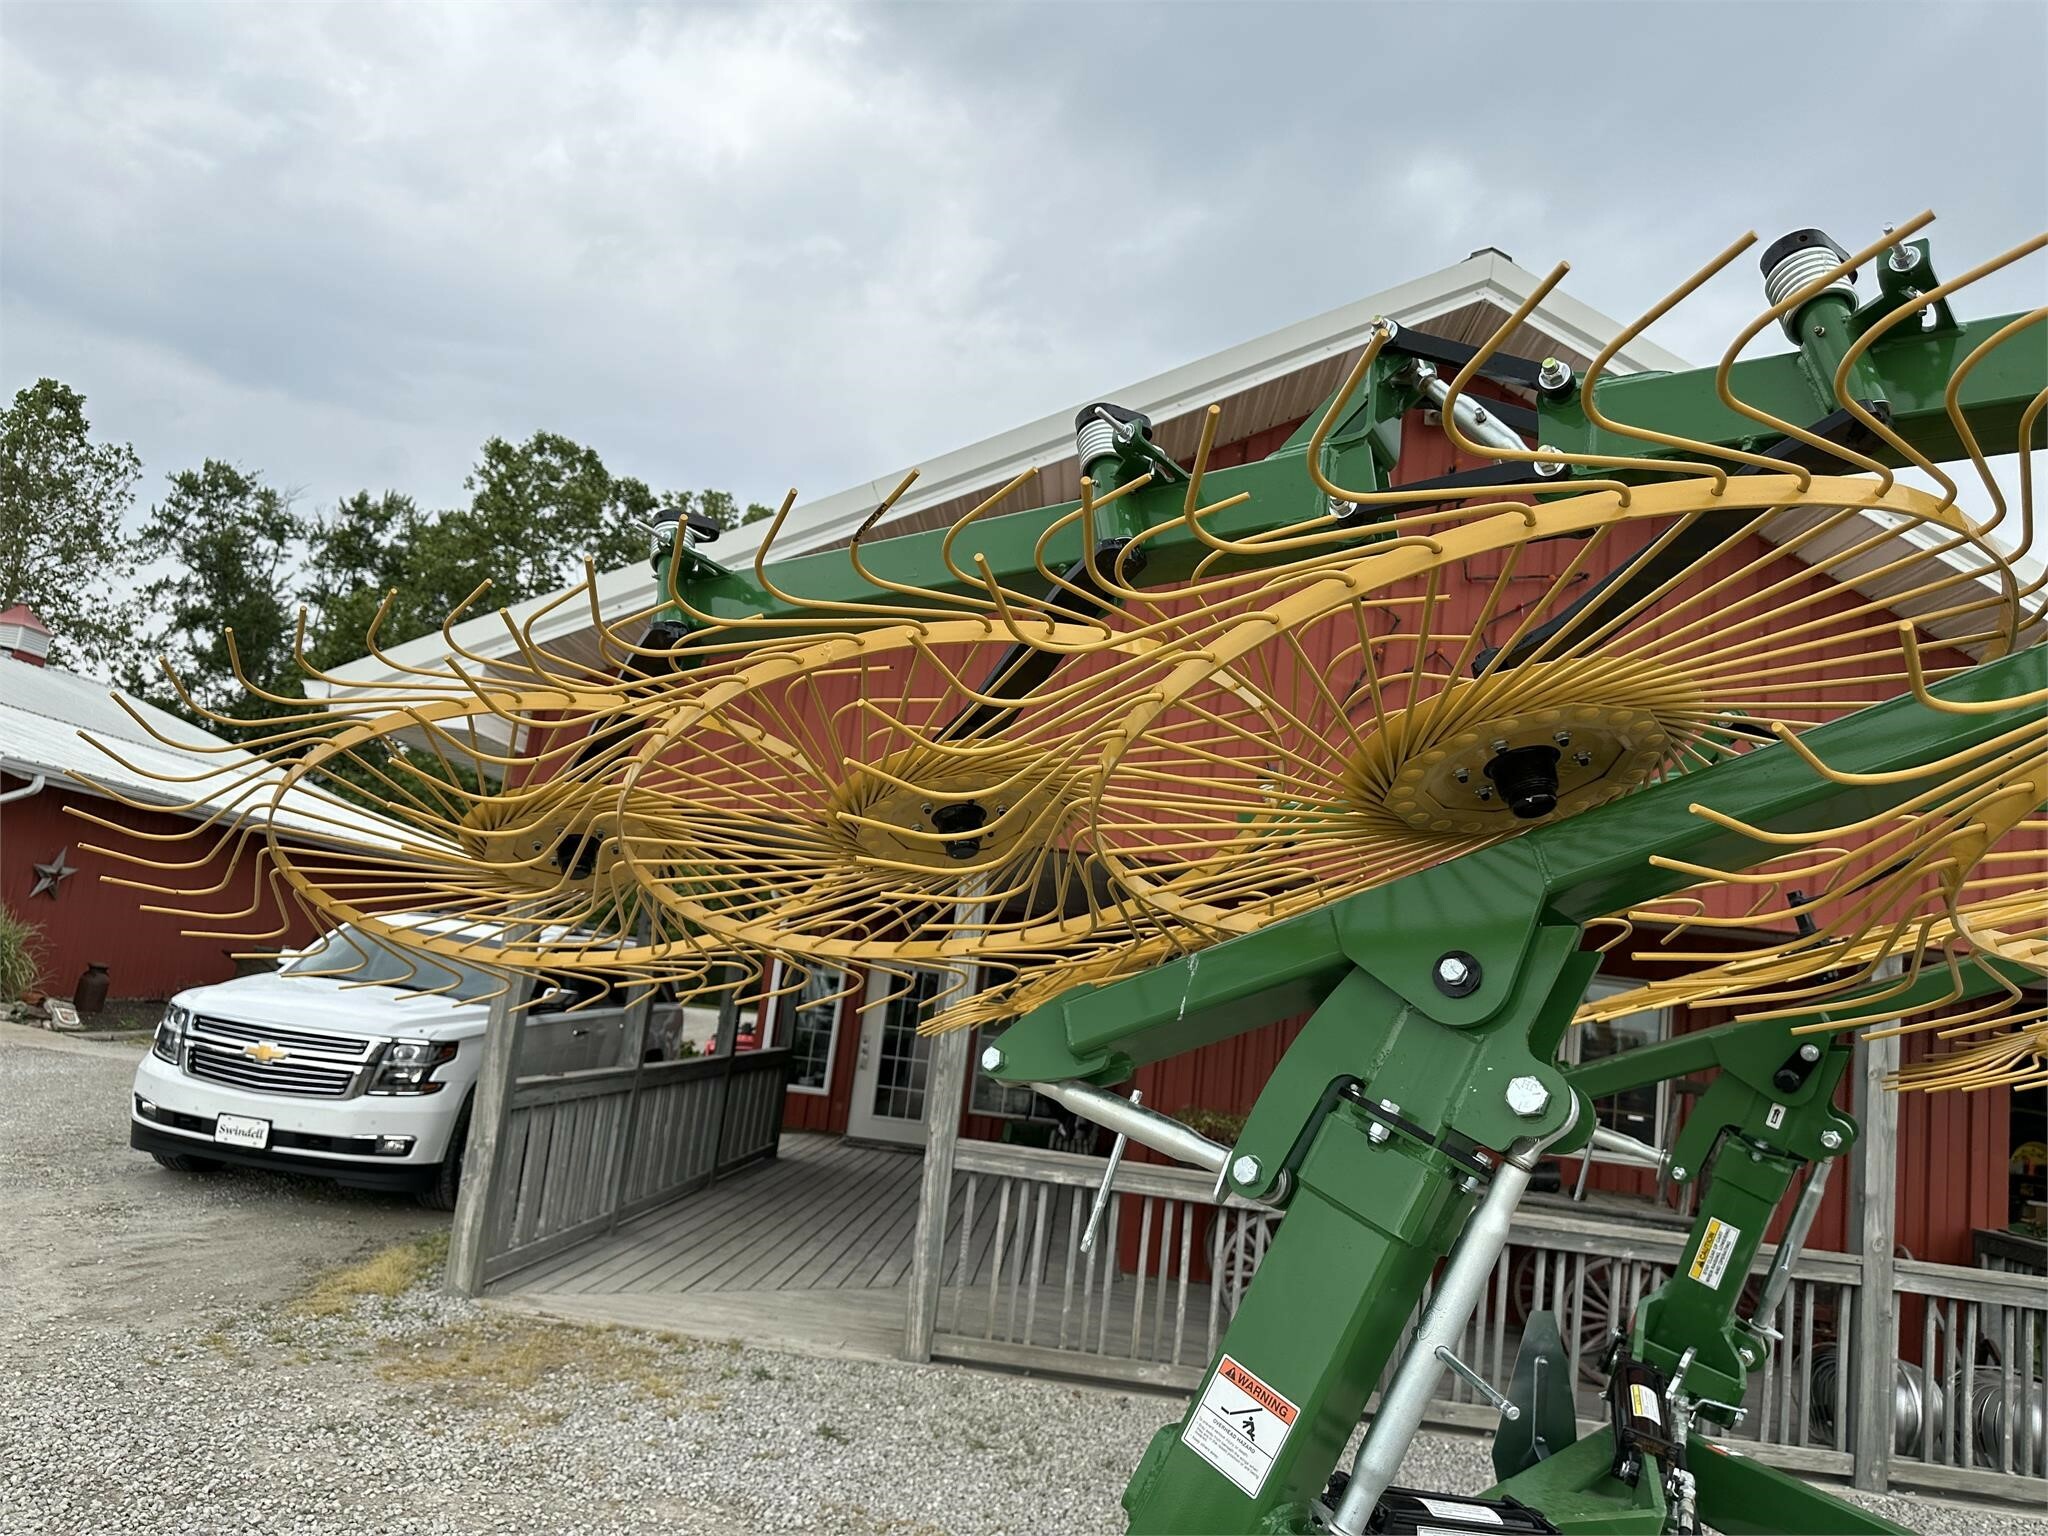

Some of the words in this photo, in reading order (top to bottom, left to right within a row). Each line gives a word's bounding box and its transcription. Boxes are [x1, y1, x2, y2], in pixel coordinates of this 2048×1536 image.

[218, 1124, 265, 1139] Swindell
[1698, 1231, 1715, 1260] CAUTION
[1238, 1373, 1289, 1417] WARNING
[1212, 1418, 1237, 1439] OVERHEAD
[1236, 1436, 1256, 1454] HAZARD
